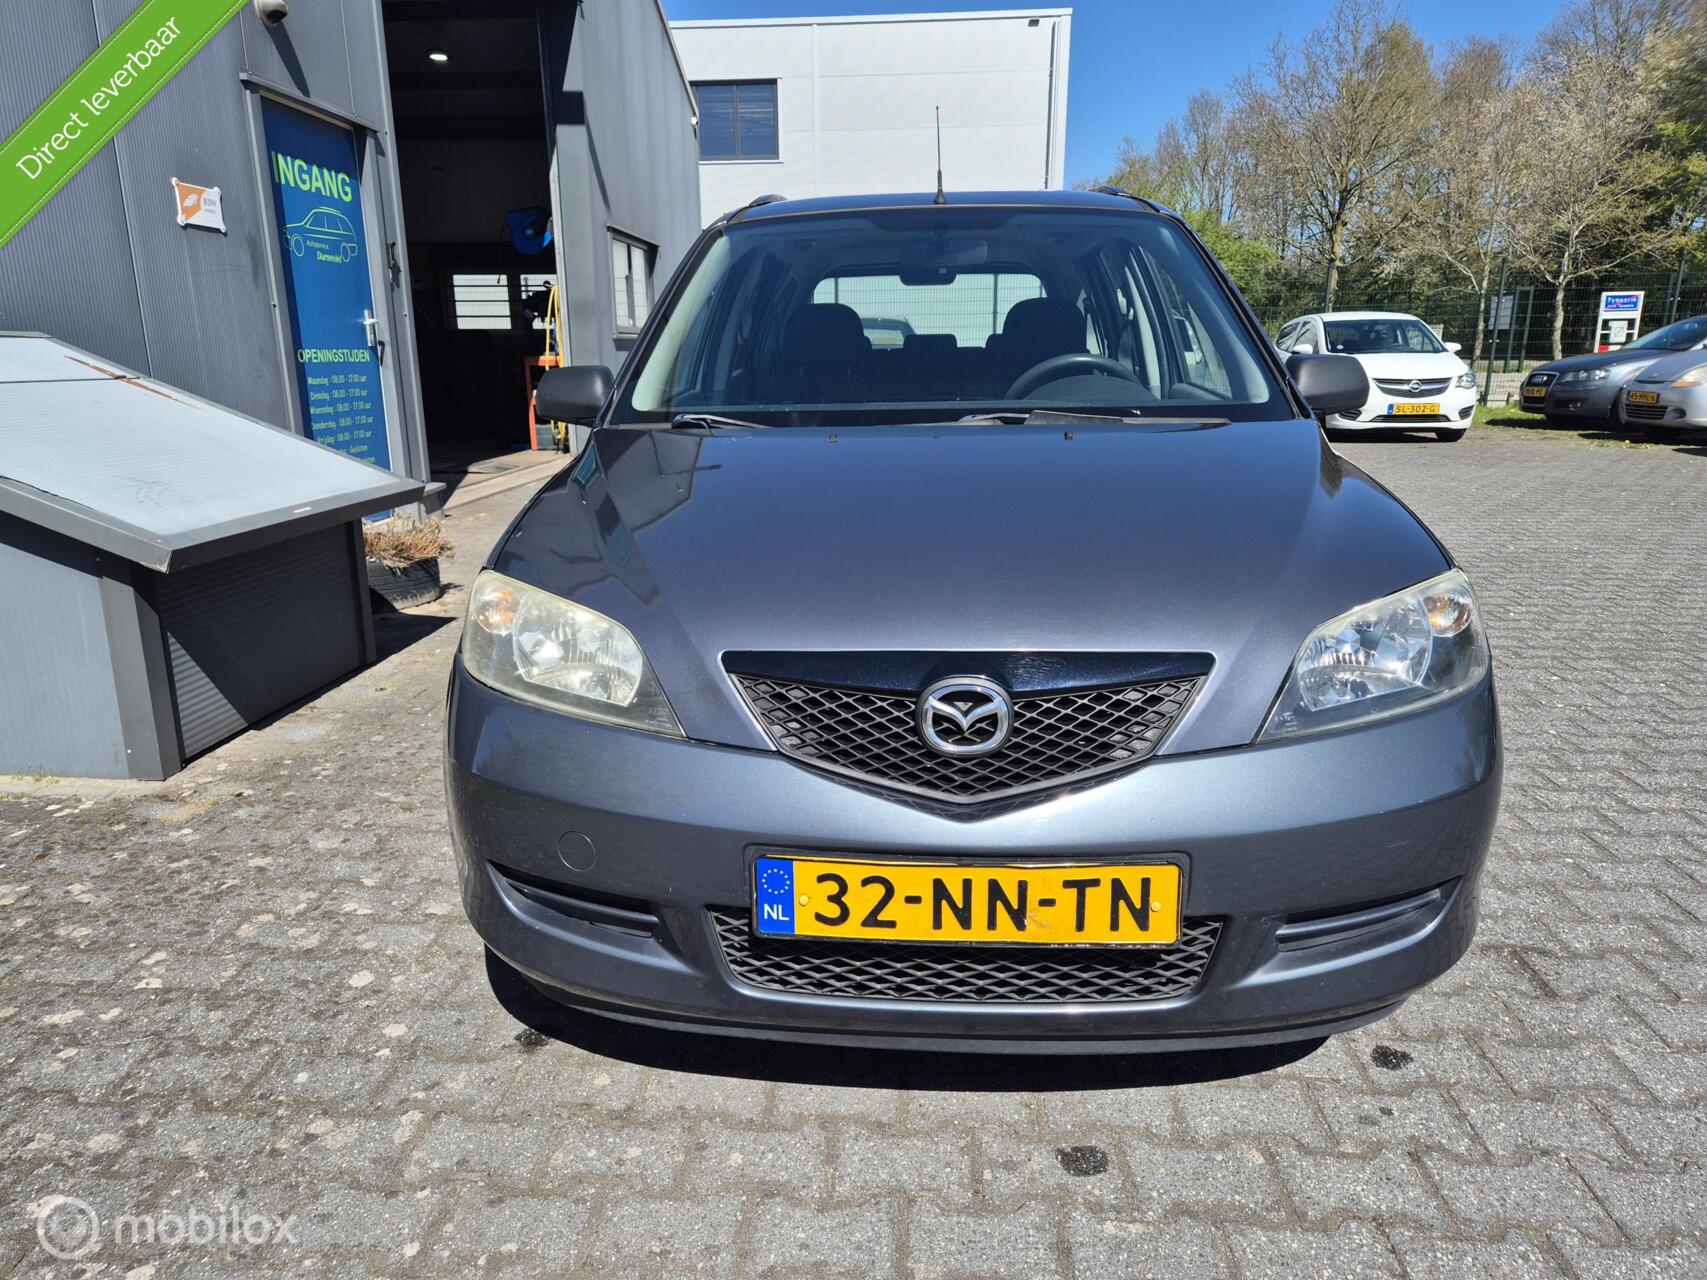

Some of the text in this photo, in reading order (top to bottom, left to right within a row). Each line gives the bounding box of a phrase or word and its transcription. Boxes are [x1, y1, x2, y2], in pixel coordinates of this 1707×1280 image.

[271, 150, 352, 202] INGANG
[298, 348, 370, 362] OPENINGSTIJDEN
[1395, 405, 1435, 413] SL-302-G
[763, 873, 1151, 932] NL 32-NN-TN
